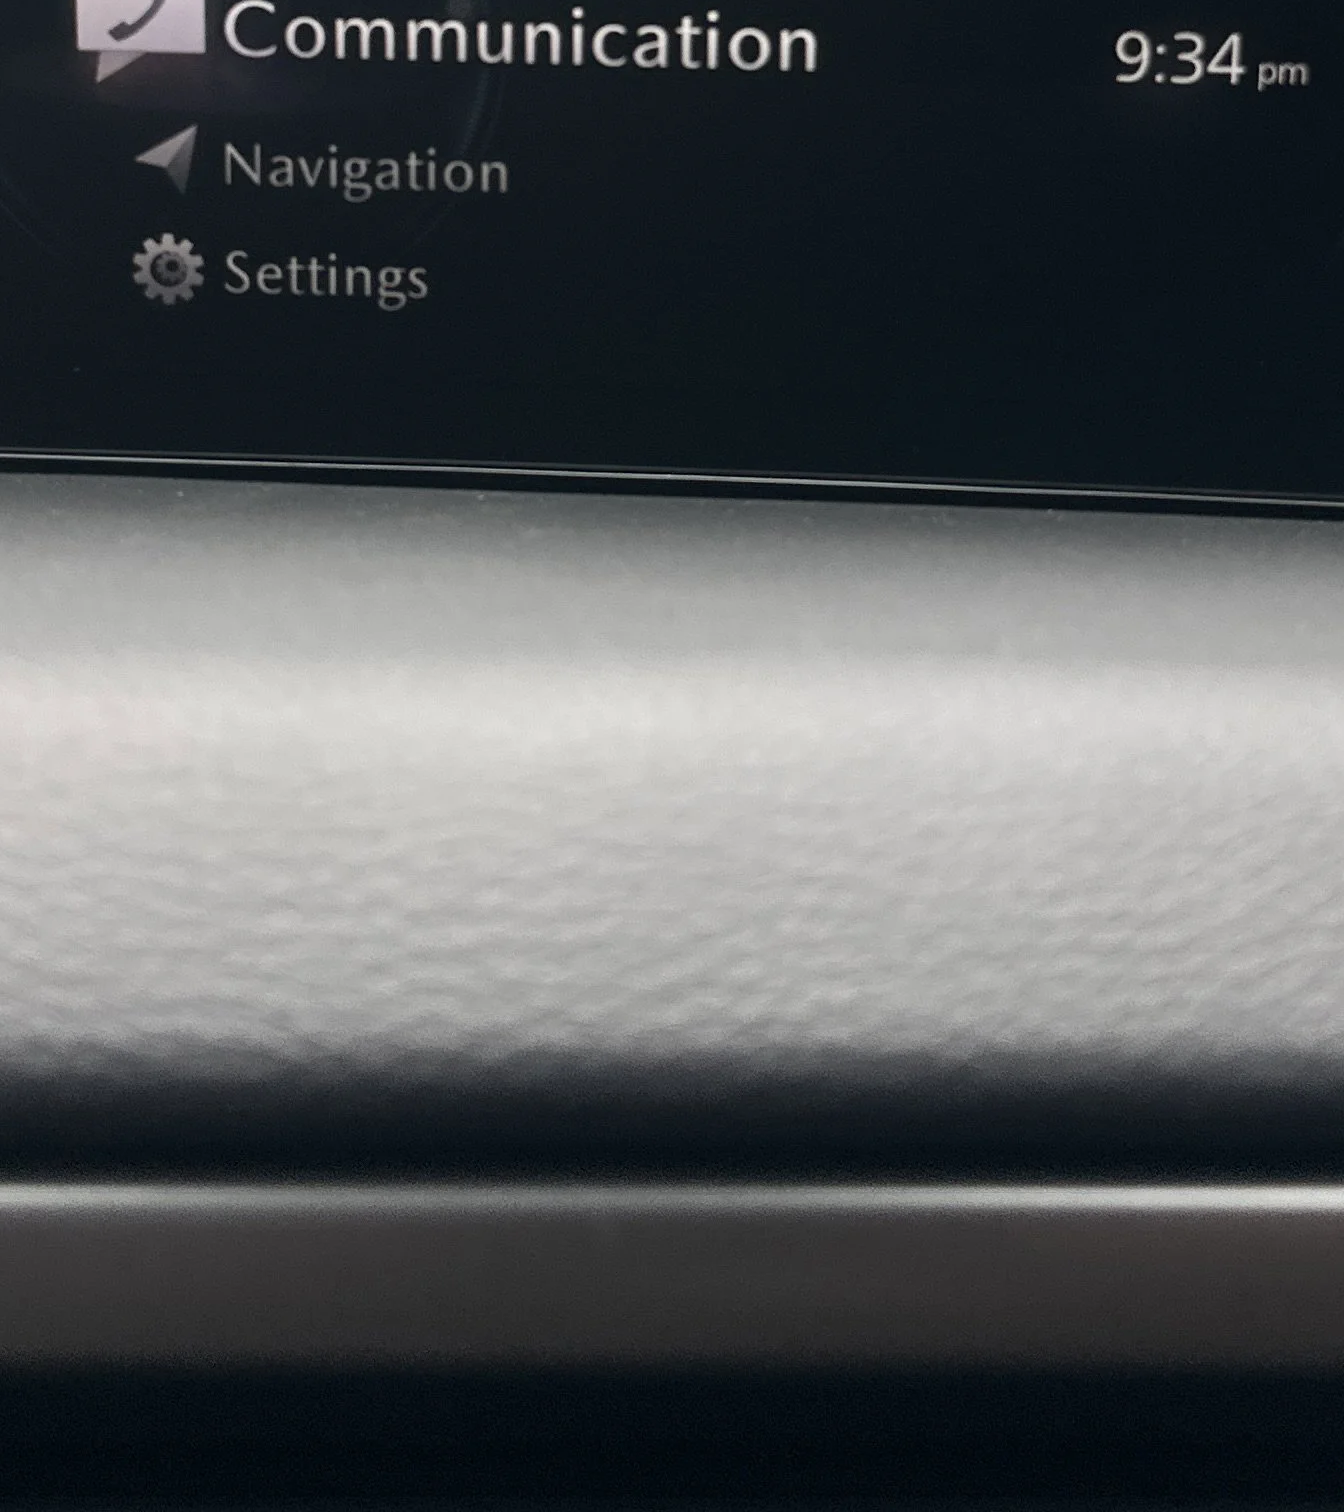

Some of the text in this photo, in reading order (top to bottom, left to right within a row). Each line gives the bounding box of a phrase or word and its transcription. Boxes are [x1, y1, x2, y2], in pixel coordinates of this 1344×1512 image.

[1115, 29, 1310, 91] 9:34 pm
[224, 143, 509, 202] Navigation
[224, 249, 429, 311] Settings
